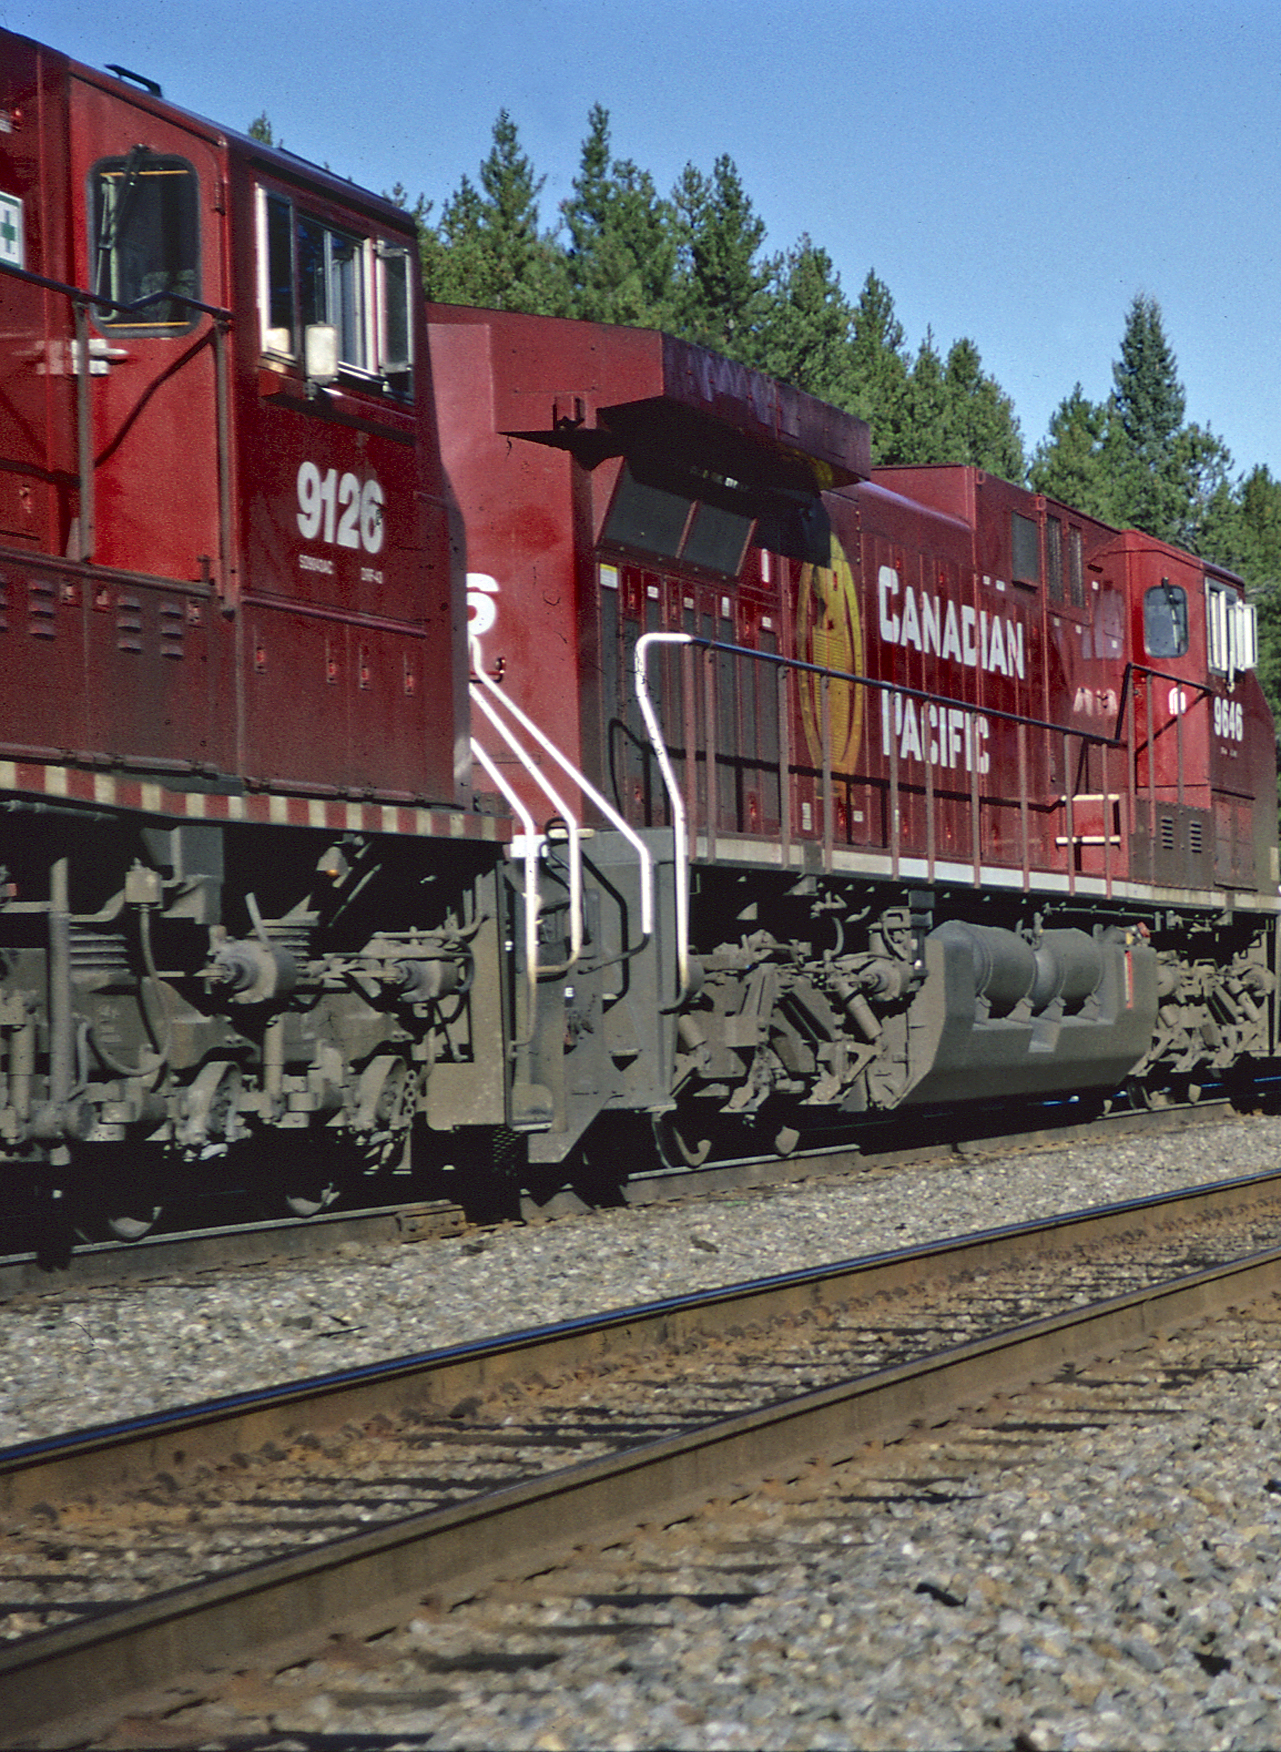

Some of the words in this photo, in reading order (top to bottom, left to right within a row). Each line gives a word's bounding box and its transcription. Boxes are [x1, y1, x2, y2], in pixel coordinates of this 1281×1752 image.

[296, 461, 384, 554] 9126
[878, 565, 1025, 680] CANADIAN
[881, 680, 990, 774] PACIFIC
[1214, 696, 1244, 742] 9646
